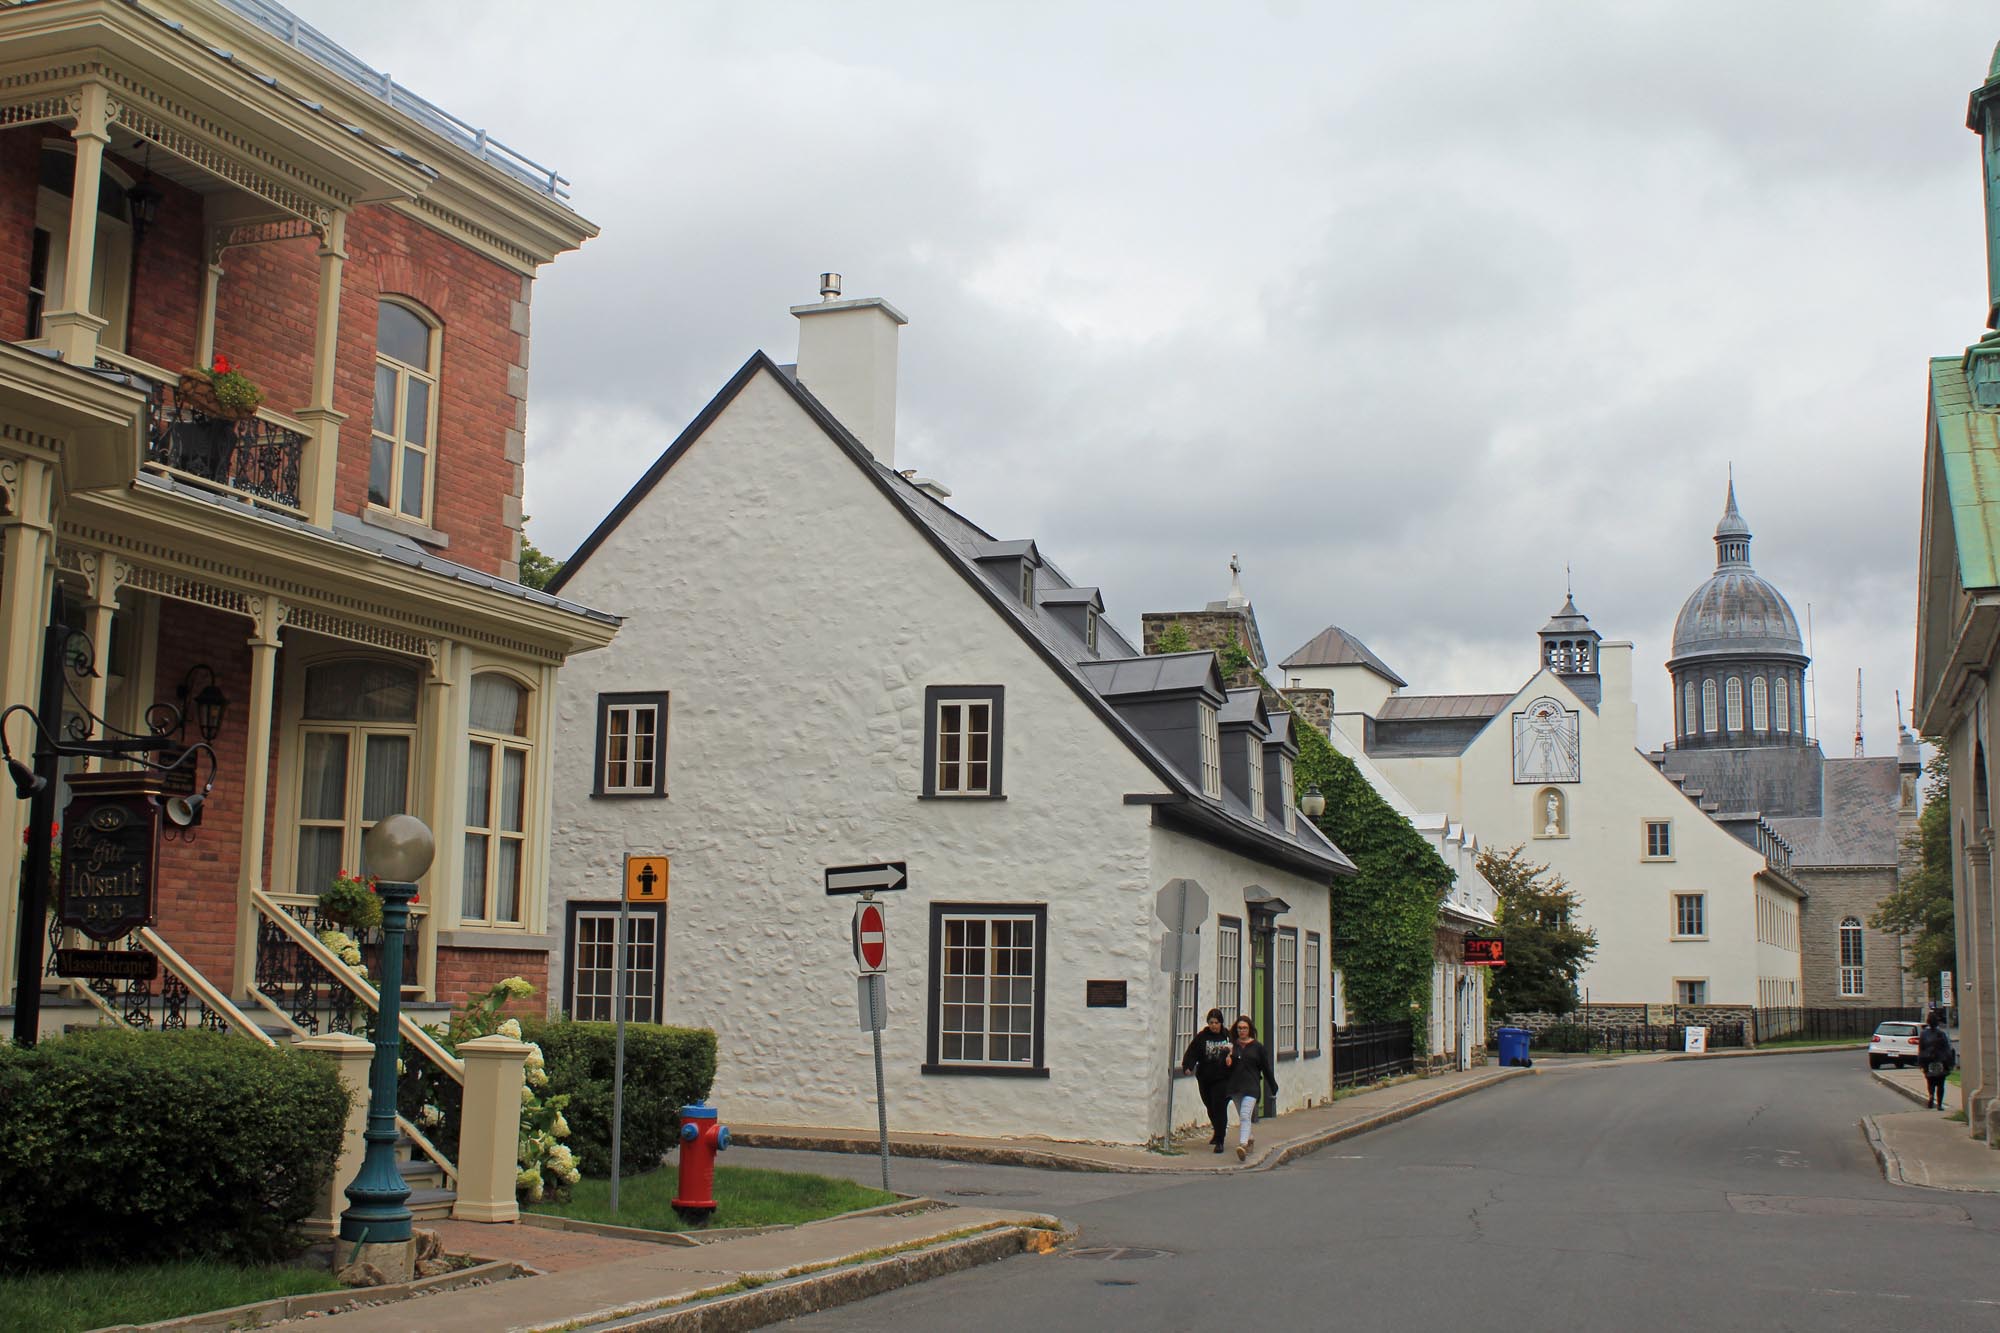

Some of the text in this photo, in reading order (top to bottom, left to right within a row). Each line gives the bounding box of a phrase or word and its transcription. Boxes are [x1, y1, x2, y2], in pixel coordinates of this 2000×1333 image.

[71, 827, 90, 848] Le
[70, 862, 143, 897] LOISELLE
[61, 953, 150, 978] Massothérapie
